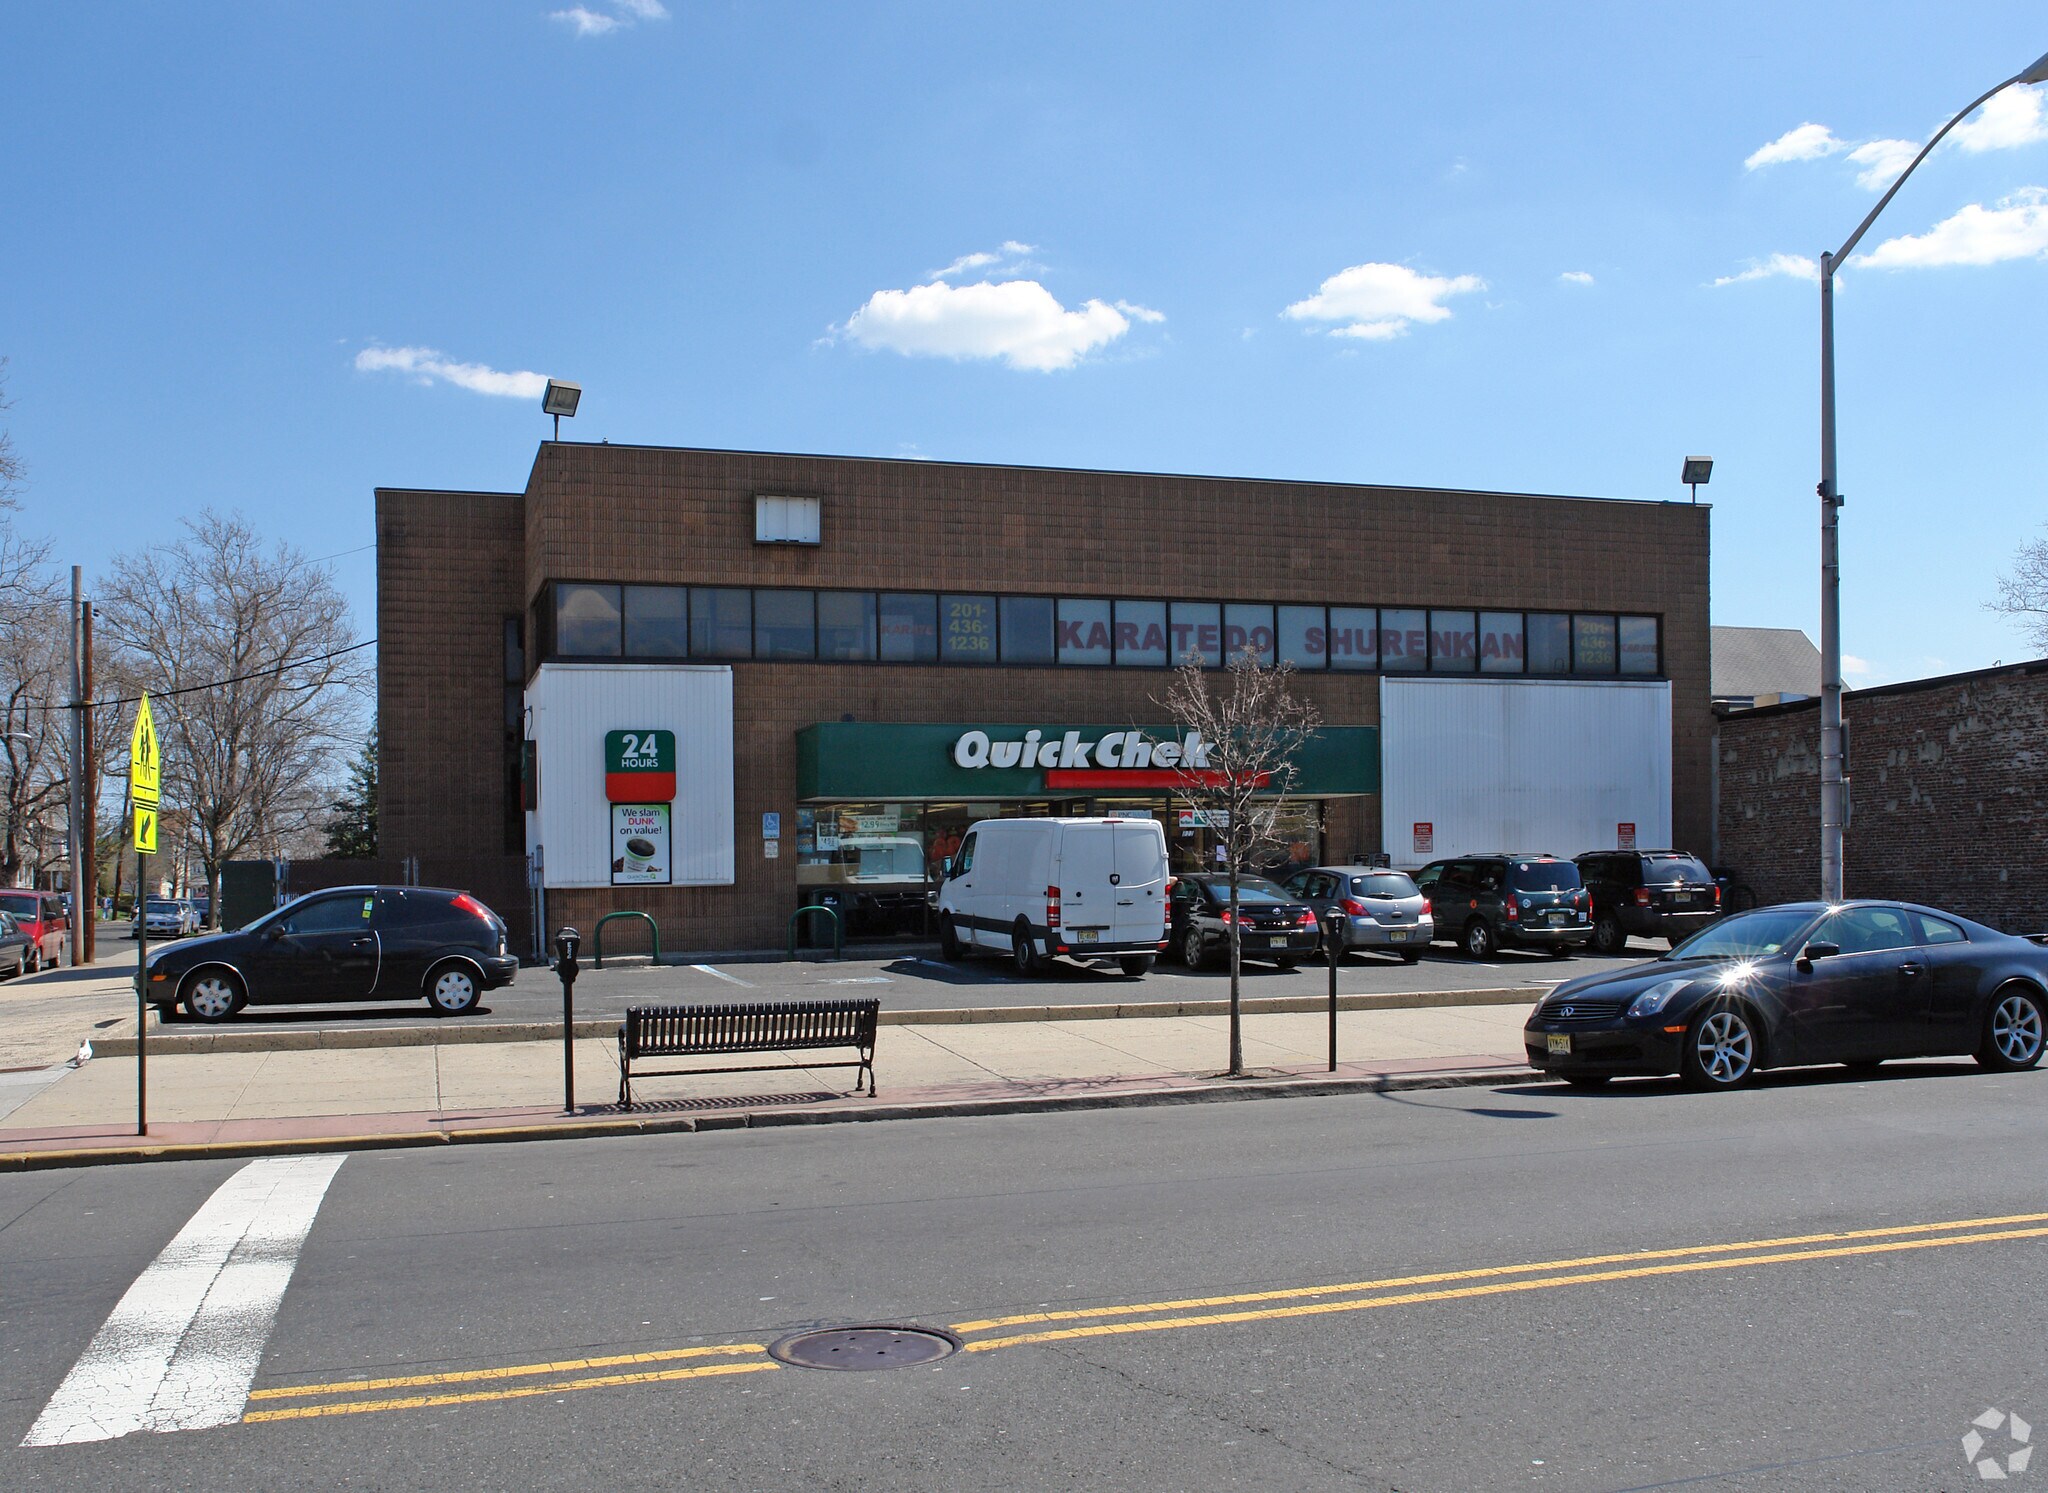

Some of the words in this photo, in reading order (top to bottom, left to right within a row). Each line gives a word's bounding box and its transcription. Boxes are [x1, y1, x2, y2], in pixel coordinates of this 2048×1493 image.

[949, 636, 989, 650] 1236
[1304, 627, 1523, 659] SHURENKAN
[622, 734, 659, 758] 24
[621, 758, 659, 768] HOURS
[622, 808, 638, 817] We
[639, 808, 661, 817] slam
[628, 818, 655, 826] DUNK
[619, 826, 633, 835] on
[634, 825, 662, 835] value!
